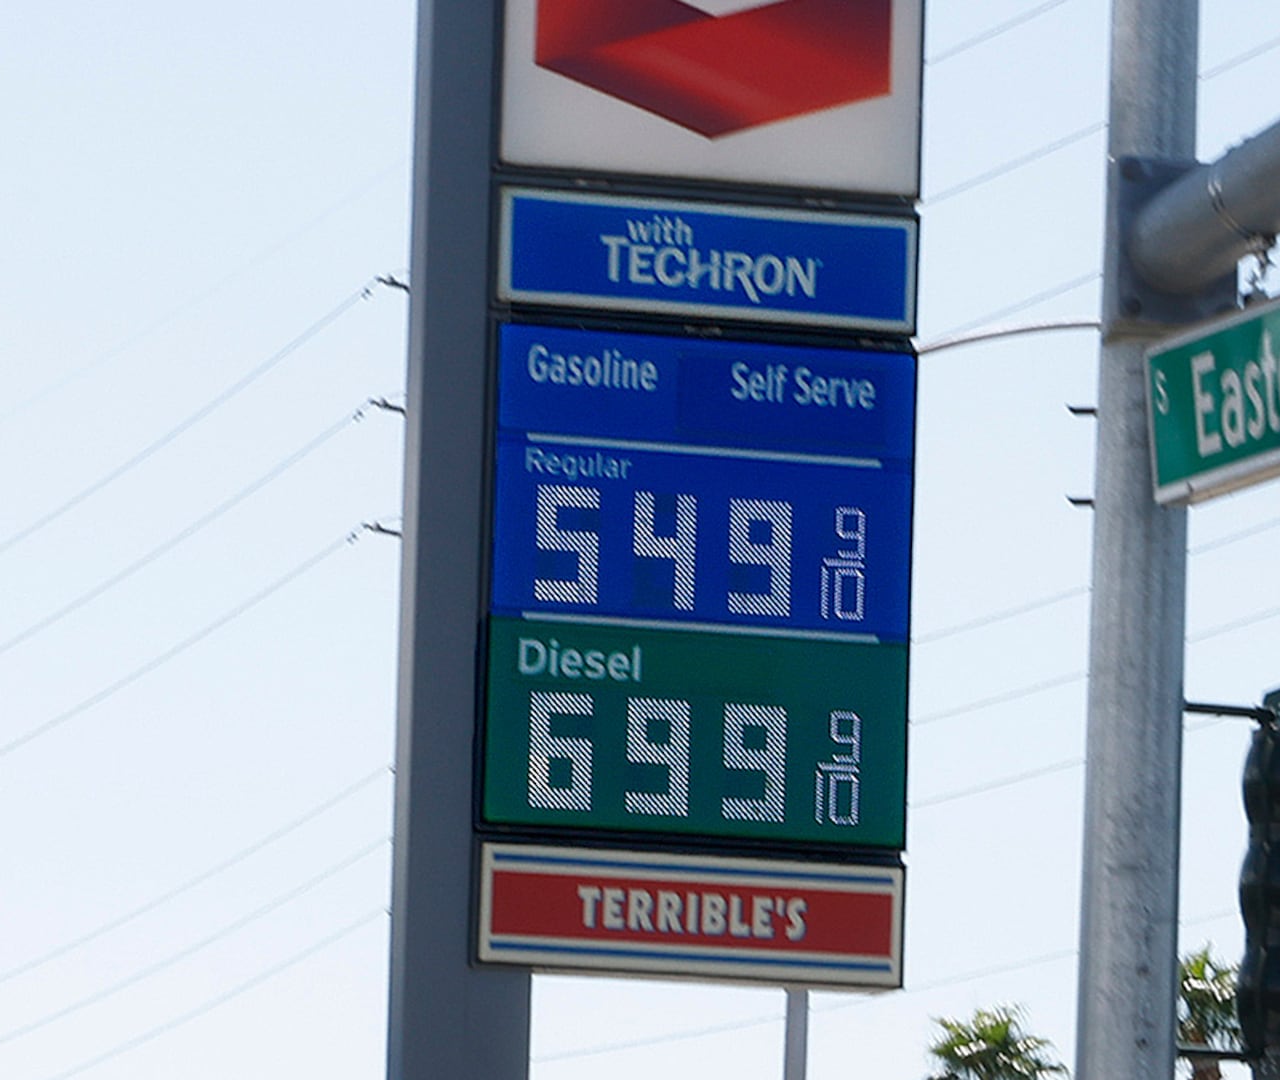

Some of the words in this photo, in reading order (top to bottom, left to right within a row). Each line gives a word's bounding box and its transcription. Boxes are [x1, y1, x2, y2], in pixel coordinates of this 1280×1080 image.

[626, 215, 694, 246] with
[600, 233, 818, 304] TECHRON
[528, 344, 658, 391] Gasoline
[730, 361, 786, 404] Self
[794, 366, 876, 411] Serve
[1154, 368, 1169, 416] S
[524, 447, 632, 480] Regular
[534, 484, 794, 617] 549
[835, 506, 865, 559] 9
[518, 638, 642, 682] Diesel
[528, 691, 788, 824] 699
[830, 710, 860, 763] 9
[577, 884, 809, 942] TERRIBLE'S
